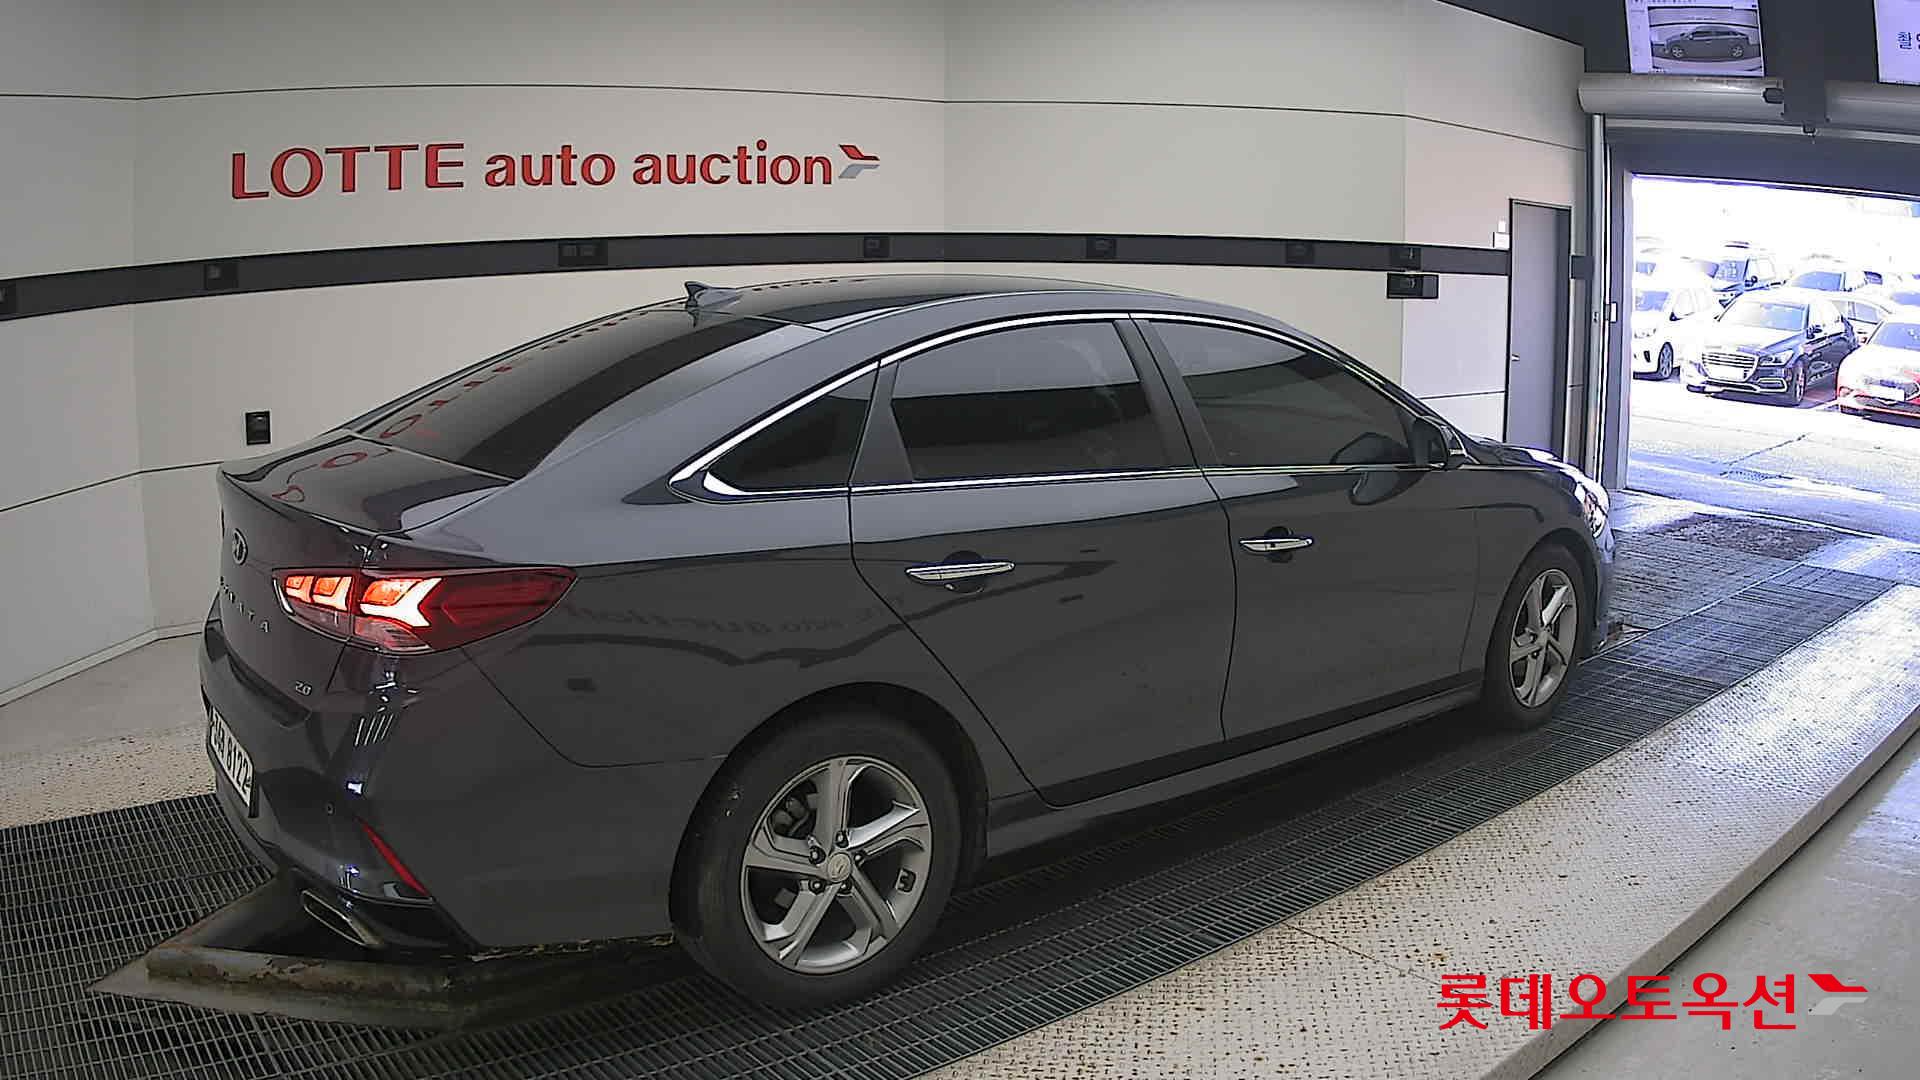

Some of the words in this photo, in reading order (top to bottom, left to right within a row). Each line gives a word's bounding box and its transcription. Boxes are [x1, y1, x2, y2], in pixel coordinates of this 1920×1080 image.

[231, 143, 464, 199] LOTTE
[485, 144, 616, 187] auto
[632, 139, 833, 186] auction
